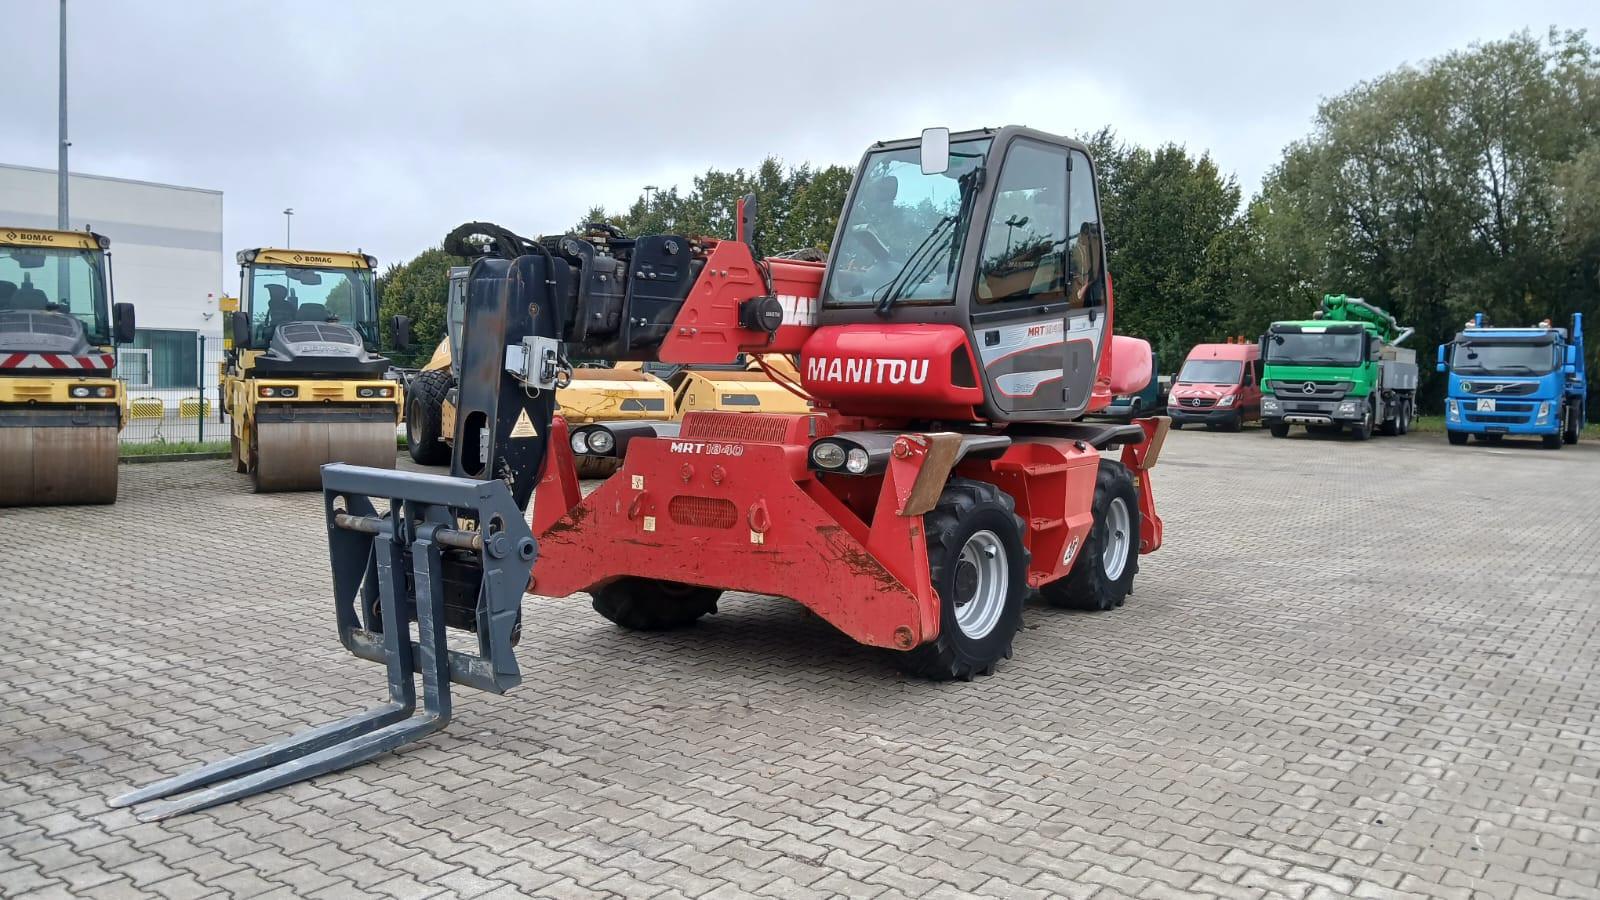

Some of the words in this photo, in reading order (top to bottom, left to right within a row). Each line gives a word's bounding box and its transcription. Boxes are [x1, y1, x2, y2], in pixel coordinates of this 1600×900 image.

[20, 233, 54, 241] BOMAG
[1027, 325, 1045, 336] MRT
[807, 357, 930, 384] MANITOU
[1481, 400, 1492, 409] A
[670, 441, 705, 454] MRT
[705, 443, 744, 456] 1840
